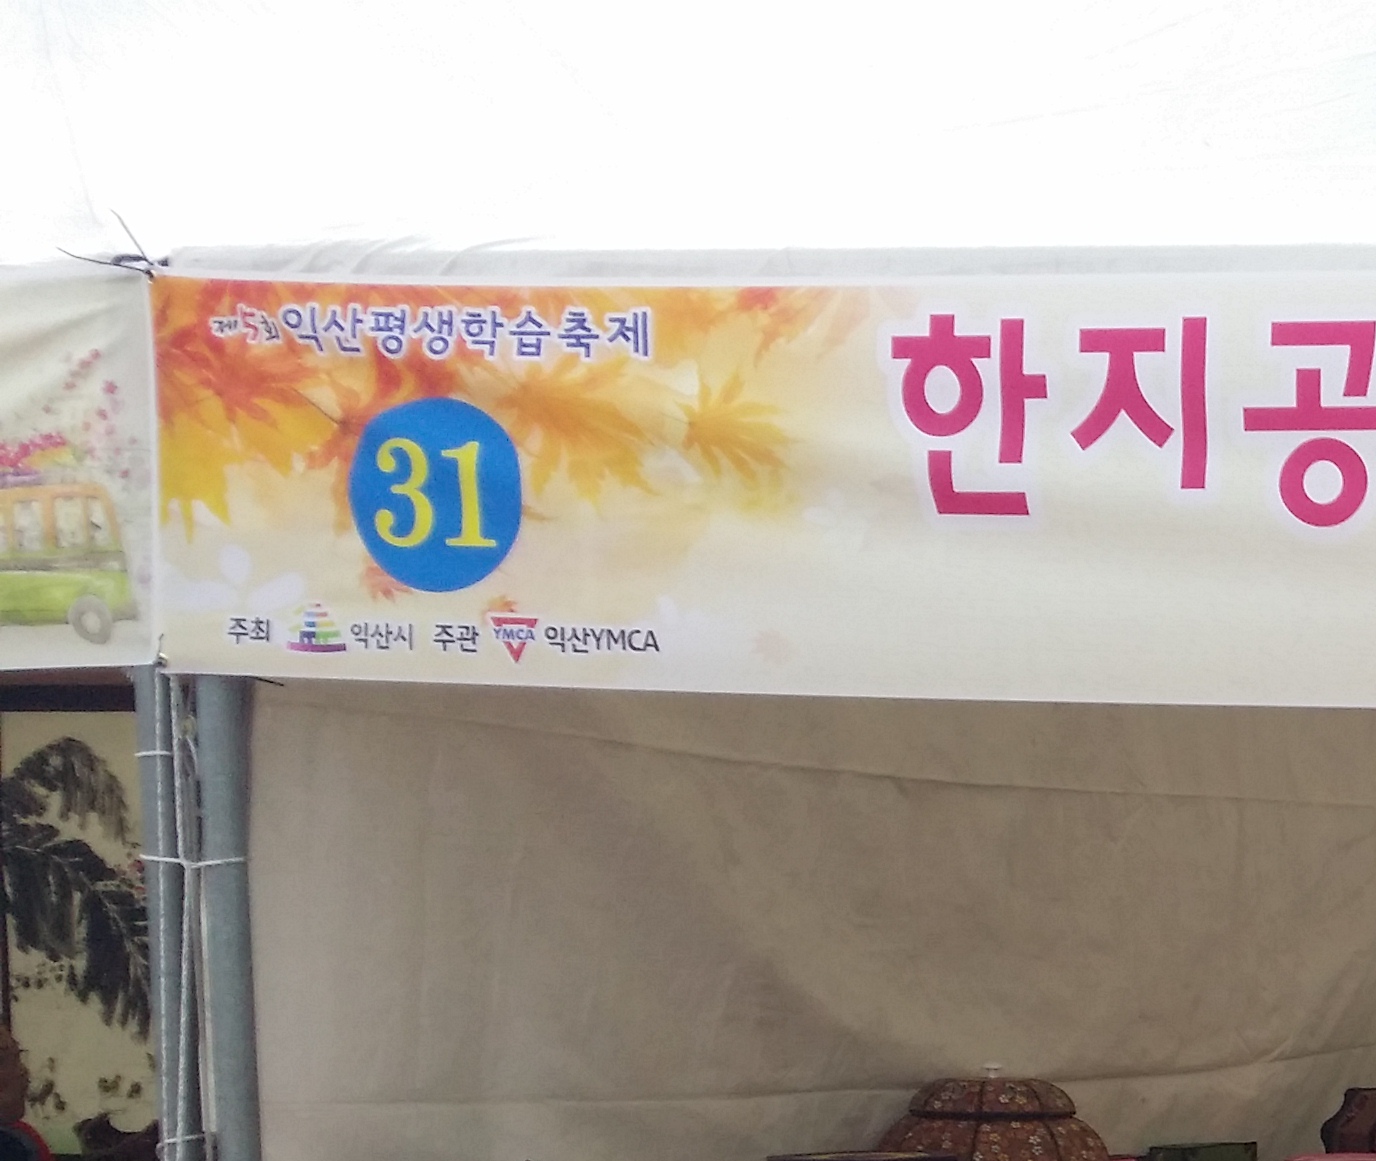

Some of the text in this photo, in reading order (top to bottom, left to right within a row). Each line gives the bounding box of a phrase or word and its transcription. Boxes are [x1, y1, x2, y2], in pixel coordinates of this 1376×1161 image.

[282, 307, 651, 358] 익산평생학습축제
[375, 438, 497, 549] 31
[227, 616, 661, 654] 주최 익산시 주관 YMCA 익산YMCA
